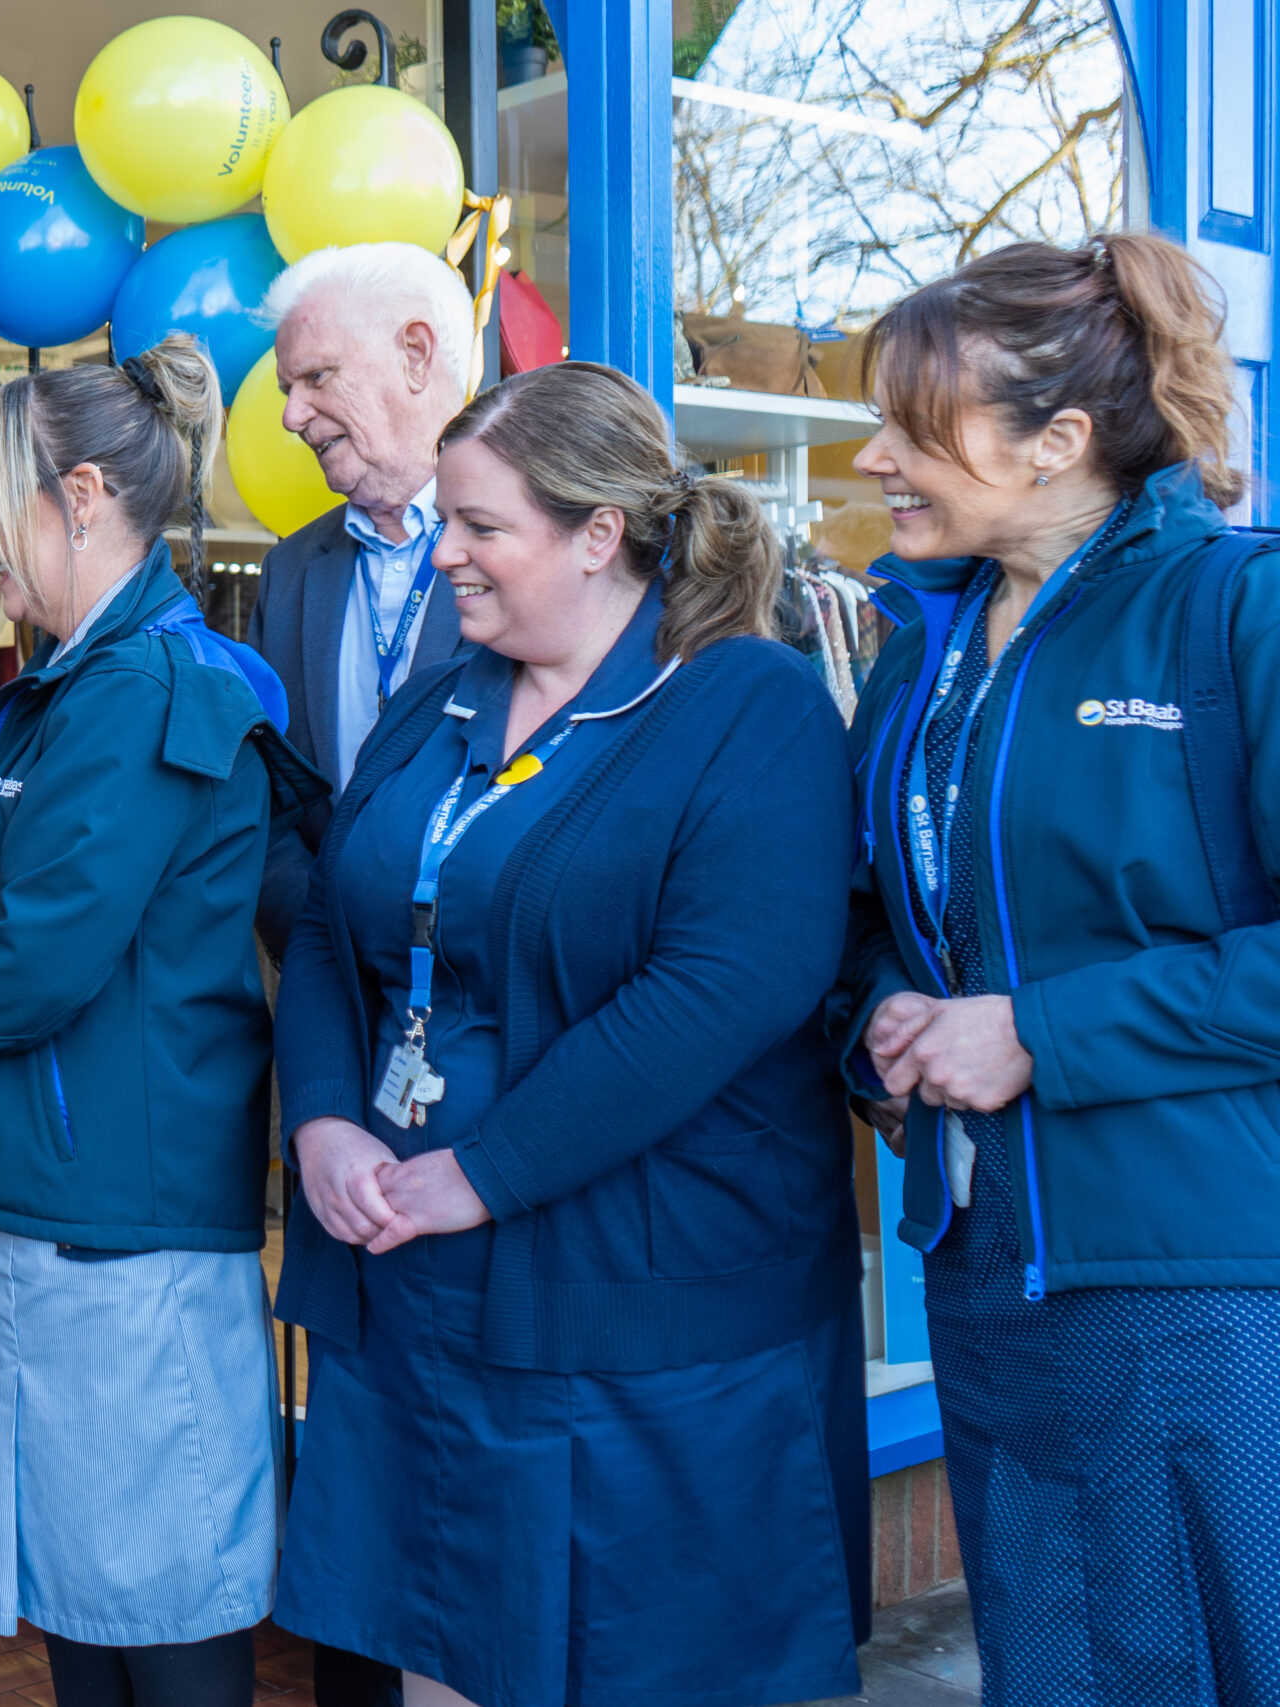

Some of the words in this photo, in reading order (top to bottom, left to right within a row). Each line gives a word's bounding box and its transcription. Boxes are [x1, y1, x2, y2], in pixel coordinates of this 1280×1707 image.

[1104, 699, 1127, 717] St
[431, 797, 458, 844] Barnabas
[916, 812, 930, 828] St
[919, 828, 939, 892] Barnabas
